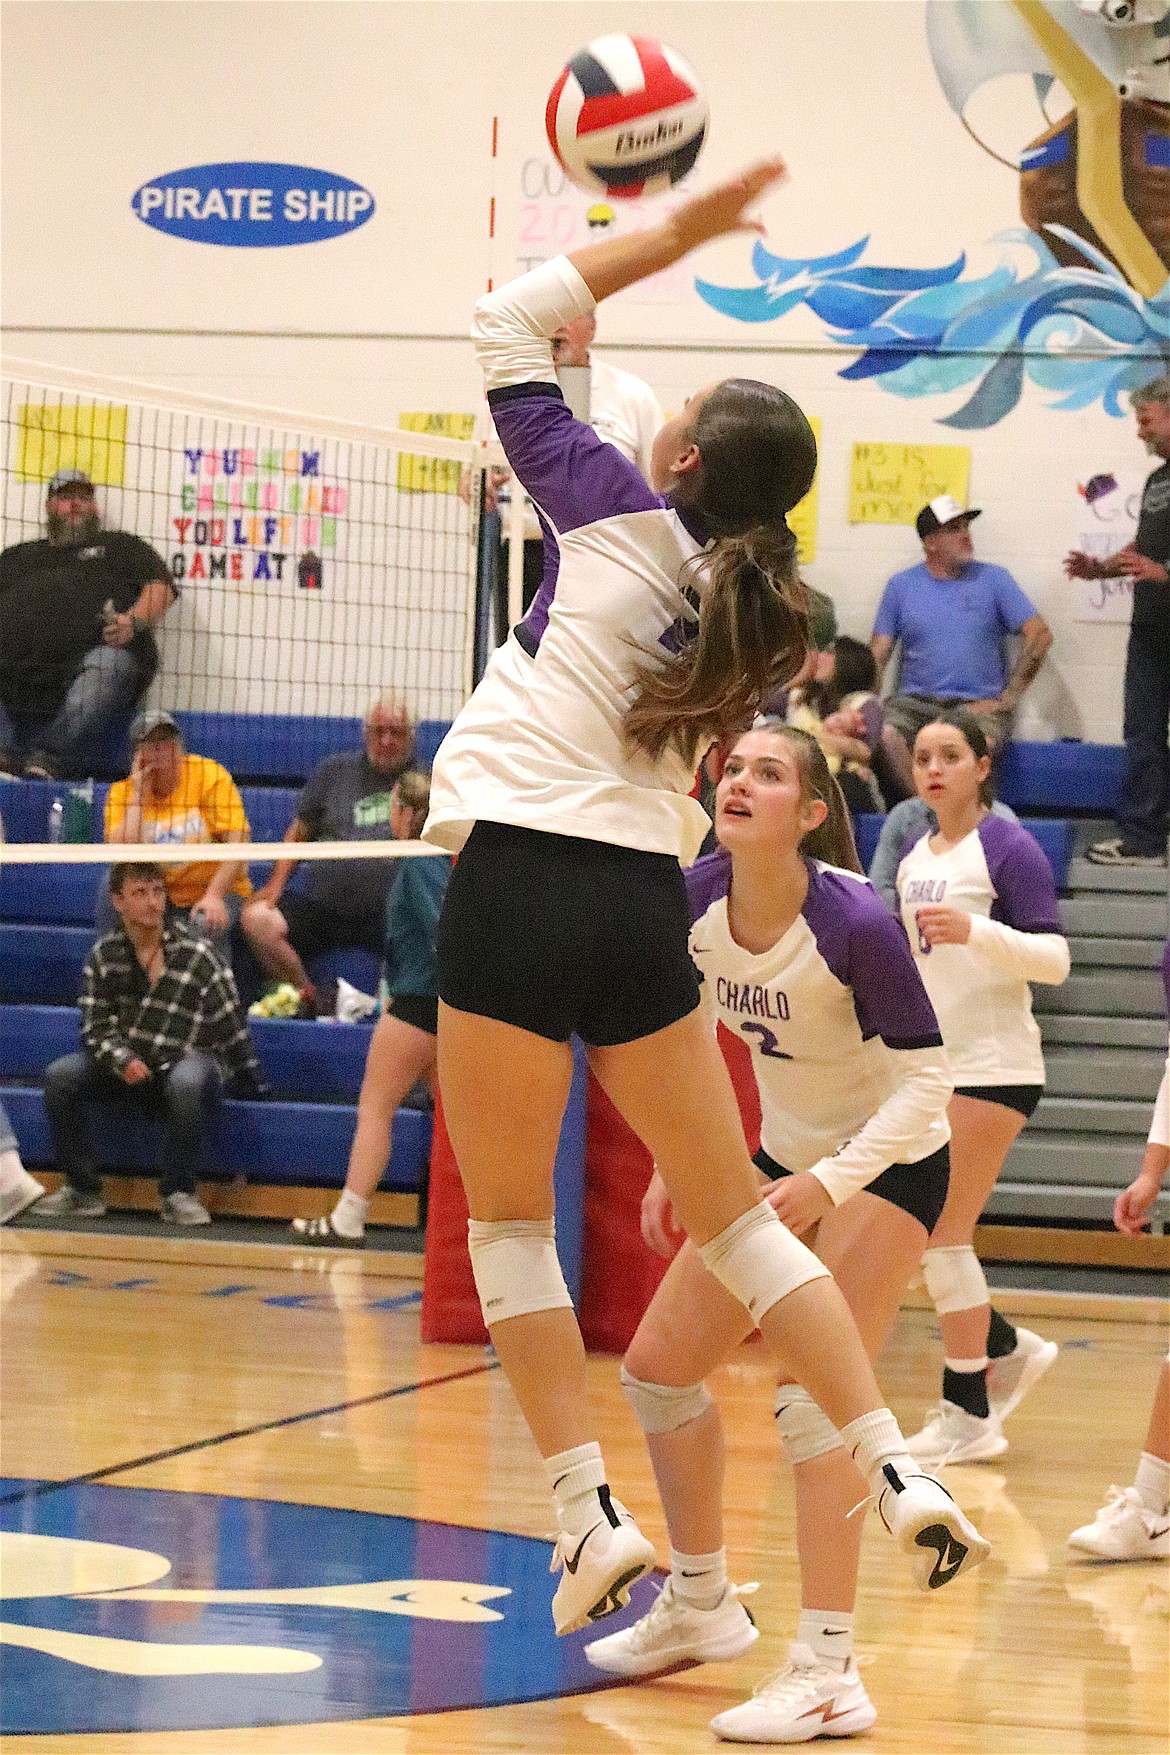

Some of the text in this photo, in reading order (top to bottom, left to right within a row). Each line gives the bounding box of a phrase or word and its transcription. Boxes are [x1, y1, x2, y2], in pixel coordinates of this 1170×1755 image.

[139, 186, 373, 223] PIRATE SHIP
[184, 448, 255, 477] YOUR
[181, 481, 278, 512] CALLED
[172, 517, 226, 547] YOU
[171, 551, 287, 581] GAME AT
[716, 975, 791, 1022] CHARLO
[740, 1021, 794, 1060] 2
